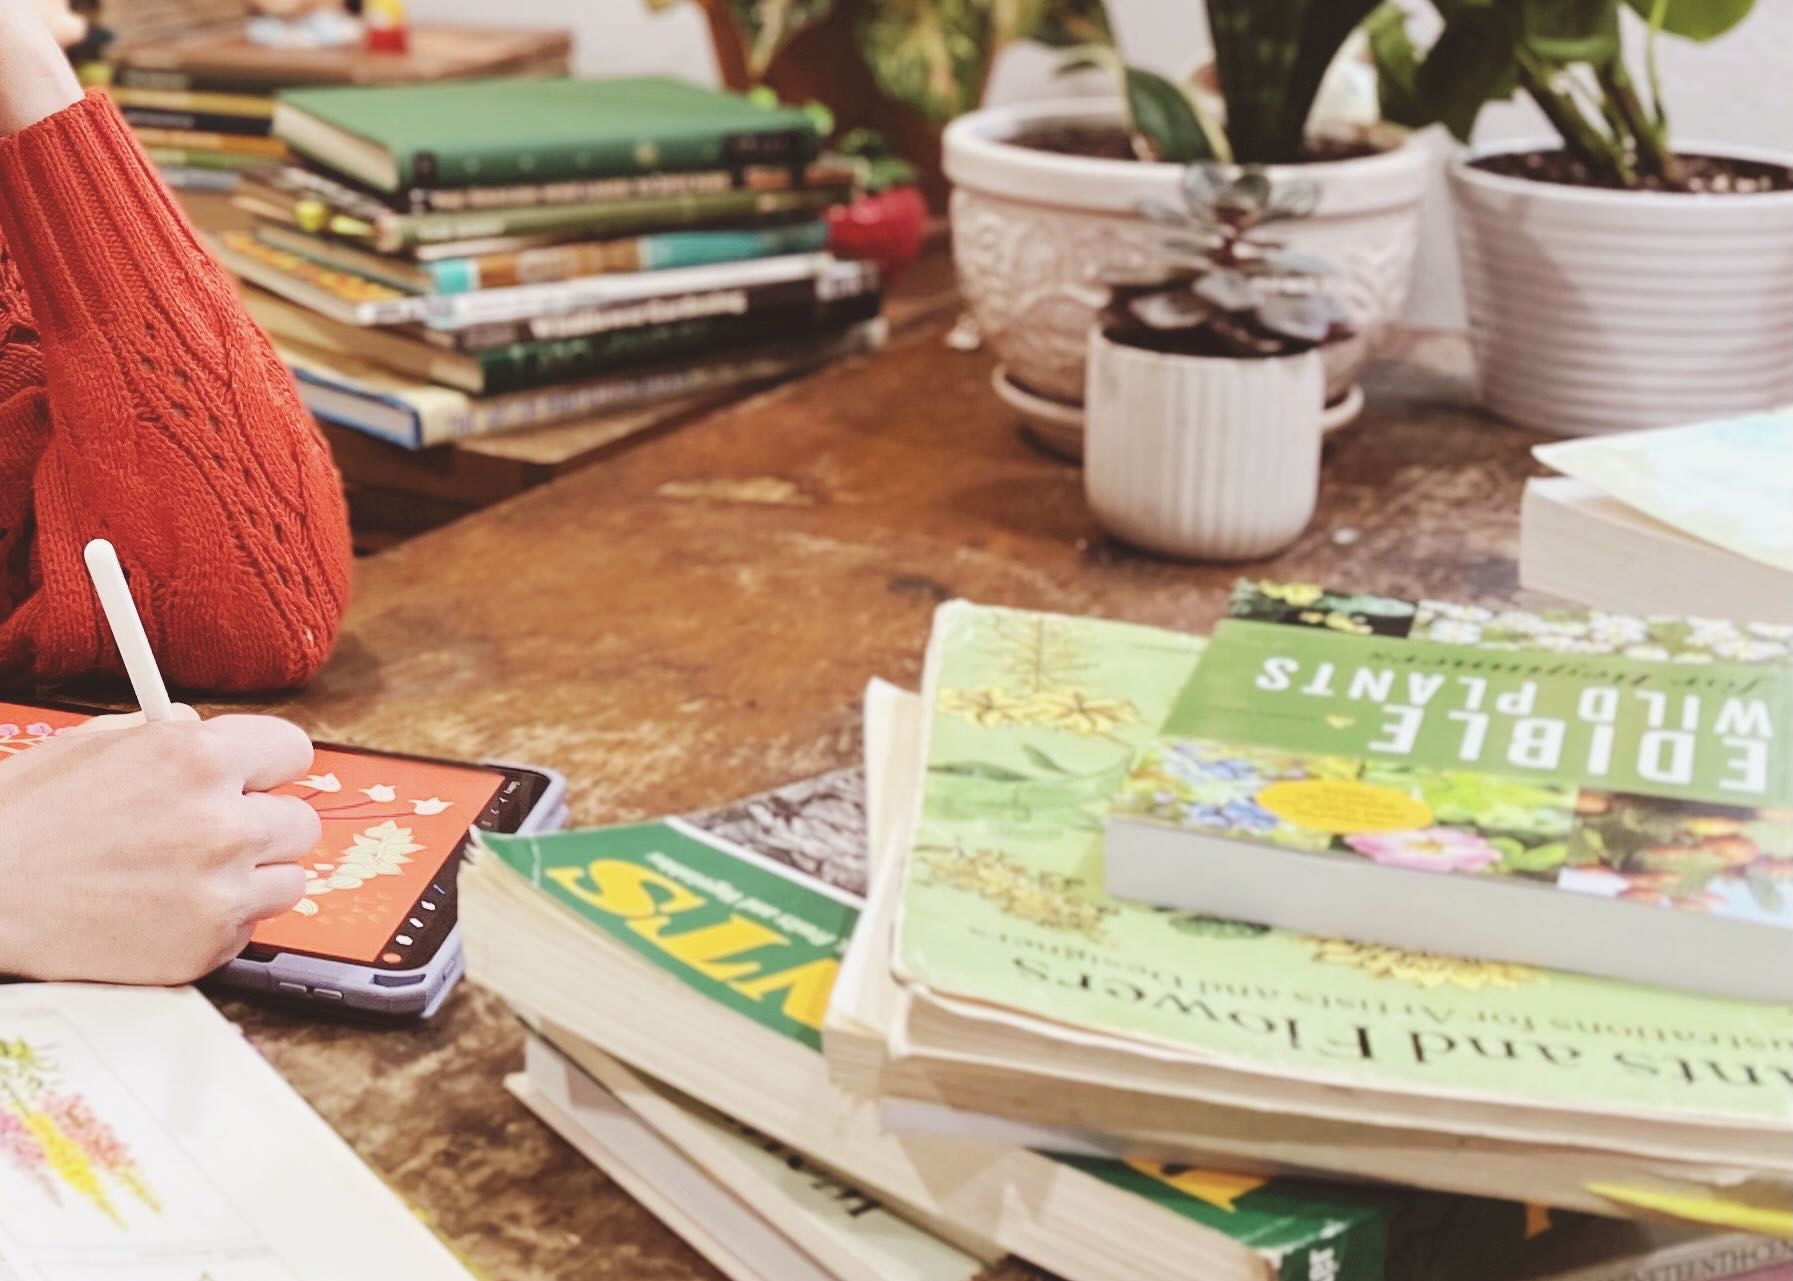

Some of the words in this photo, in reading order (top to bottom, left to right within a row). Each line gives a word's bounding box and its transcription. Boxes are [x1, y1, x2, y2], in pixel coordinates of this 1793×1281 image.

[1255, 657, 1538, 716] PLANTS
[1577, 686, 1773, 739] WILD
[1367, 704, 1769, 793] EDIBLE
[1012, 956, 1375, 1061] Flowers
[1198, 979, 1280, 1001] and
[1476, 1010, 1534, 1031] for
[1409, 1030, 1582, 1067] and
